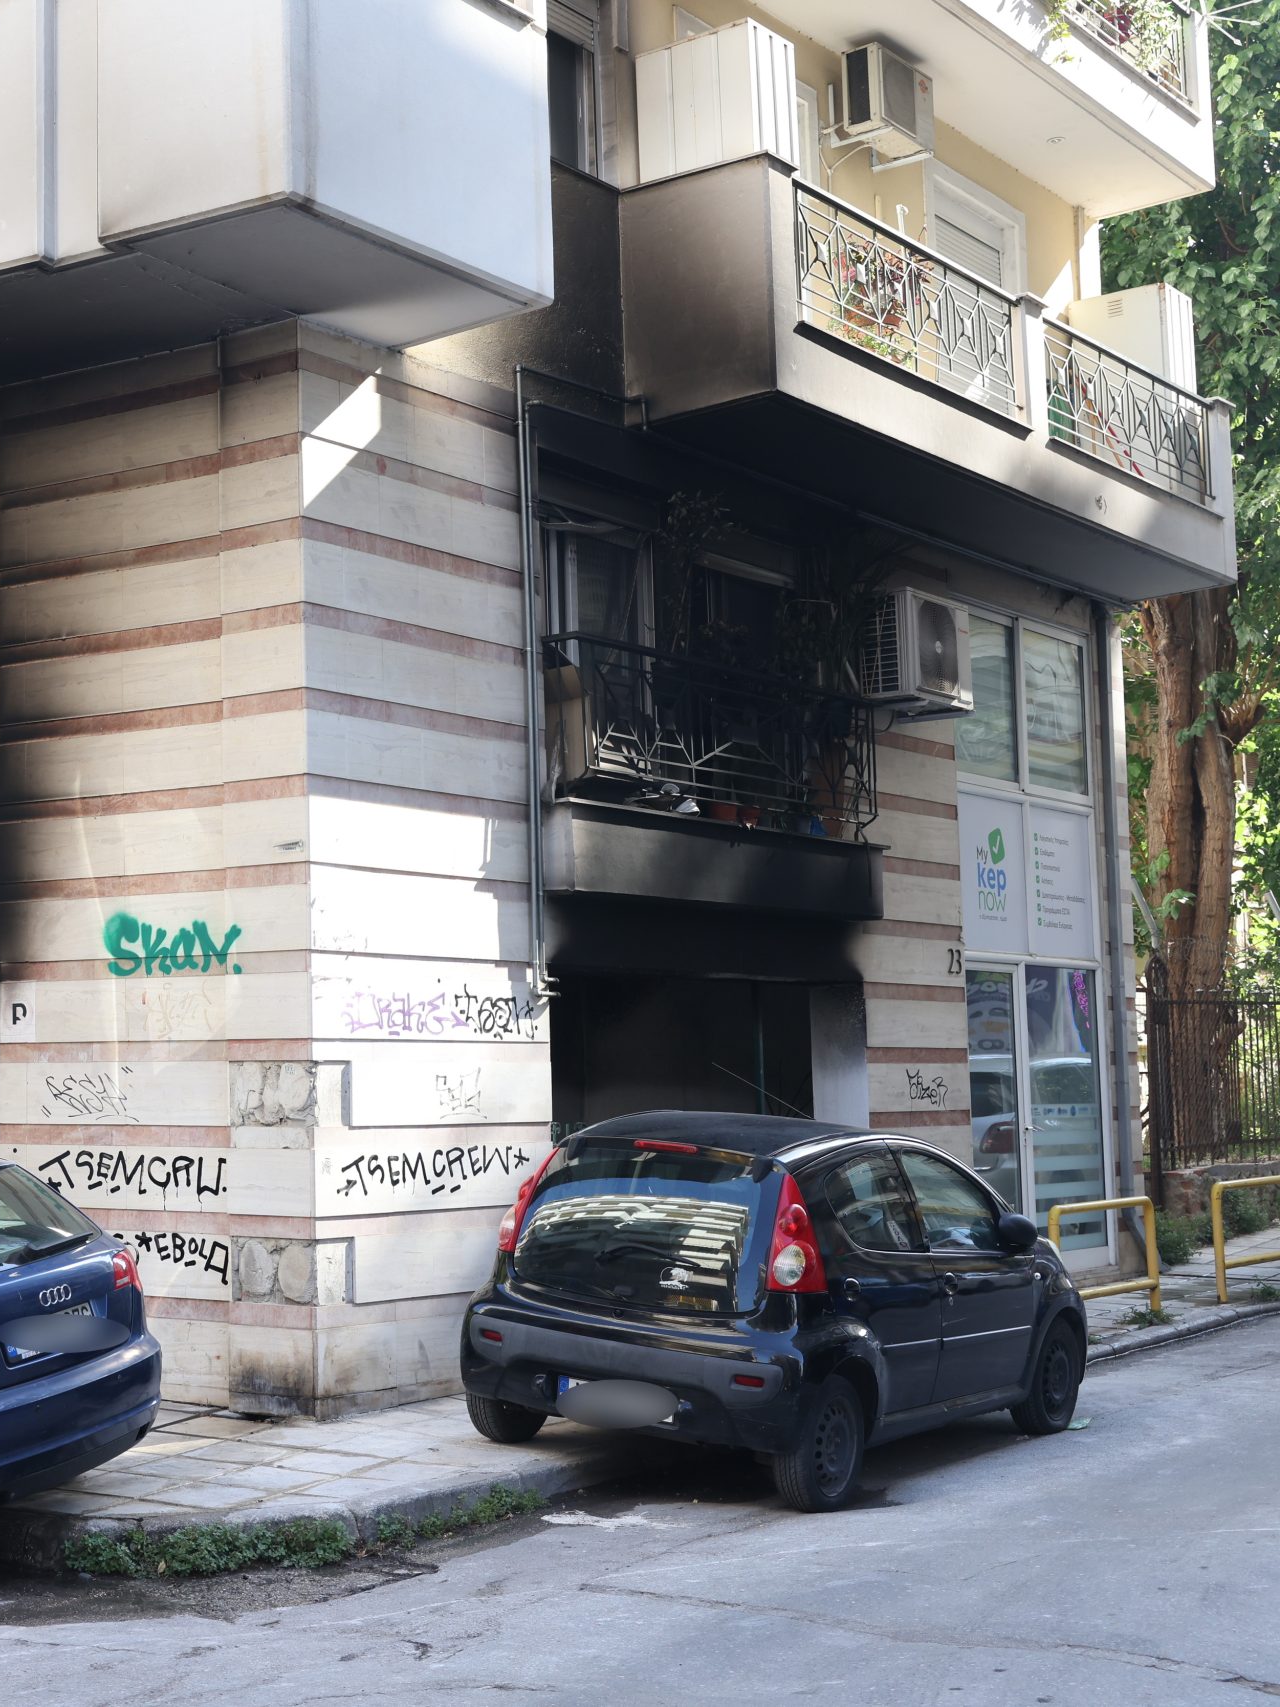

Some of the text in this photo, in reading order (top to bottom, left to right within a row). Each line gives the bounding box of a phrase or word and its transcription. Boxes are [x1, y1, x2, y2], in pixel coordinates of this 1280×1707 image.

[976, 845, 988, 864] My
[977, 862, 1007, 897] kep
[978, 890, 1007, 912] now
[947, 948, 963, 975] 23
